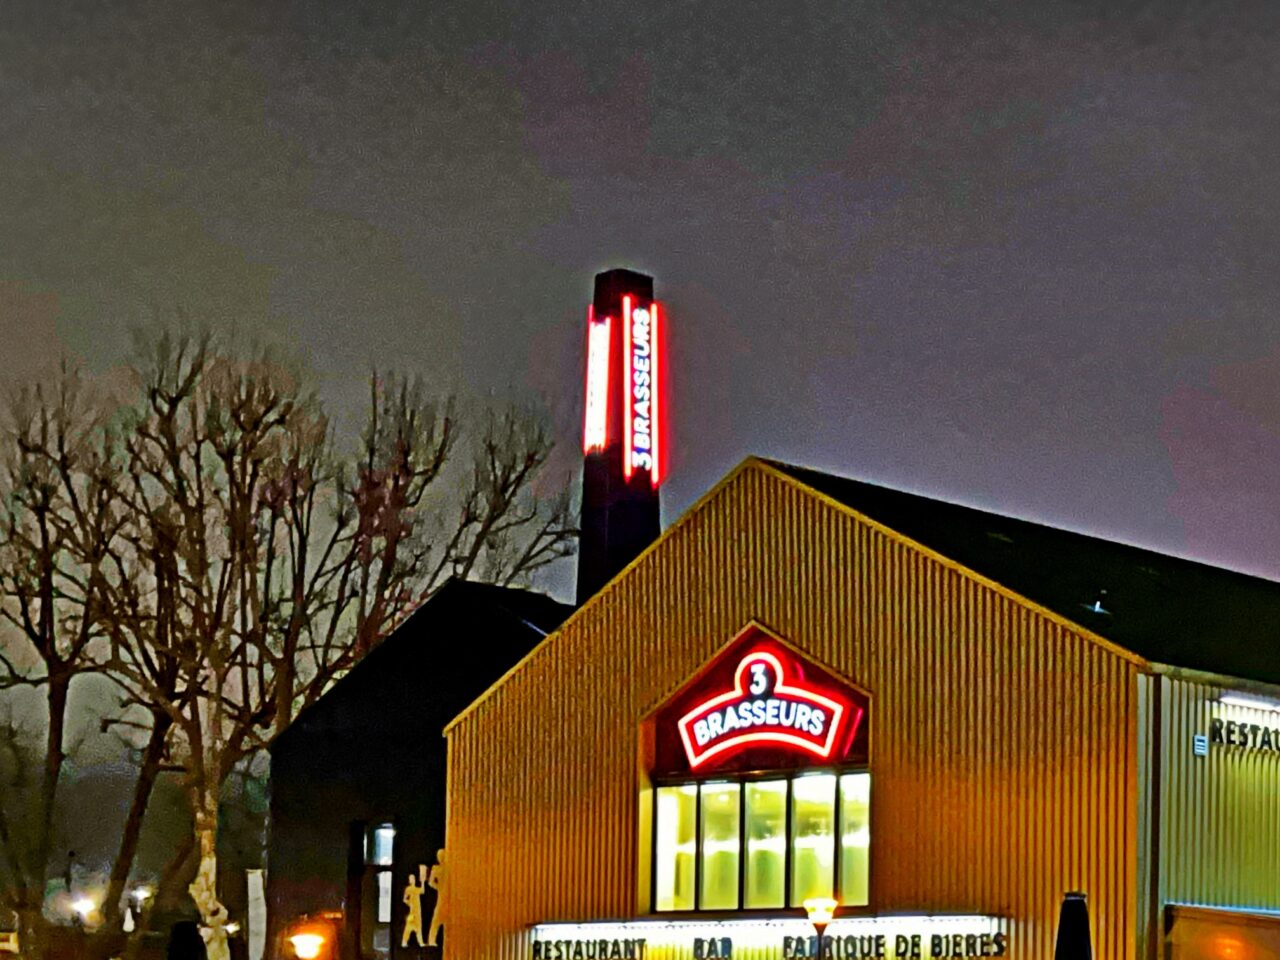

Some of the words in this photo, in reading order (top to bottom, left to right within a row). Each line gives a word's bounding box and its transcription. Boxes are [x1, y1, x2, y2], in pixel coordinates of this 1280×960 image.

[632, 308, 651, 449] BRASSEURS
[632, 450, 652, 471] 3
[749, 663, 768, 696] 3
[692, 699, 826, 747] BRASSEURS
[532, 937, 647, 960] RESTAURANT
[693, 936, 733, 960] BAR
[783, 933, 886, 960] FABRIQUE
[895, 933, 922, 958] DE
[930, 931, 1007, 958] BIERES
